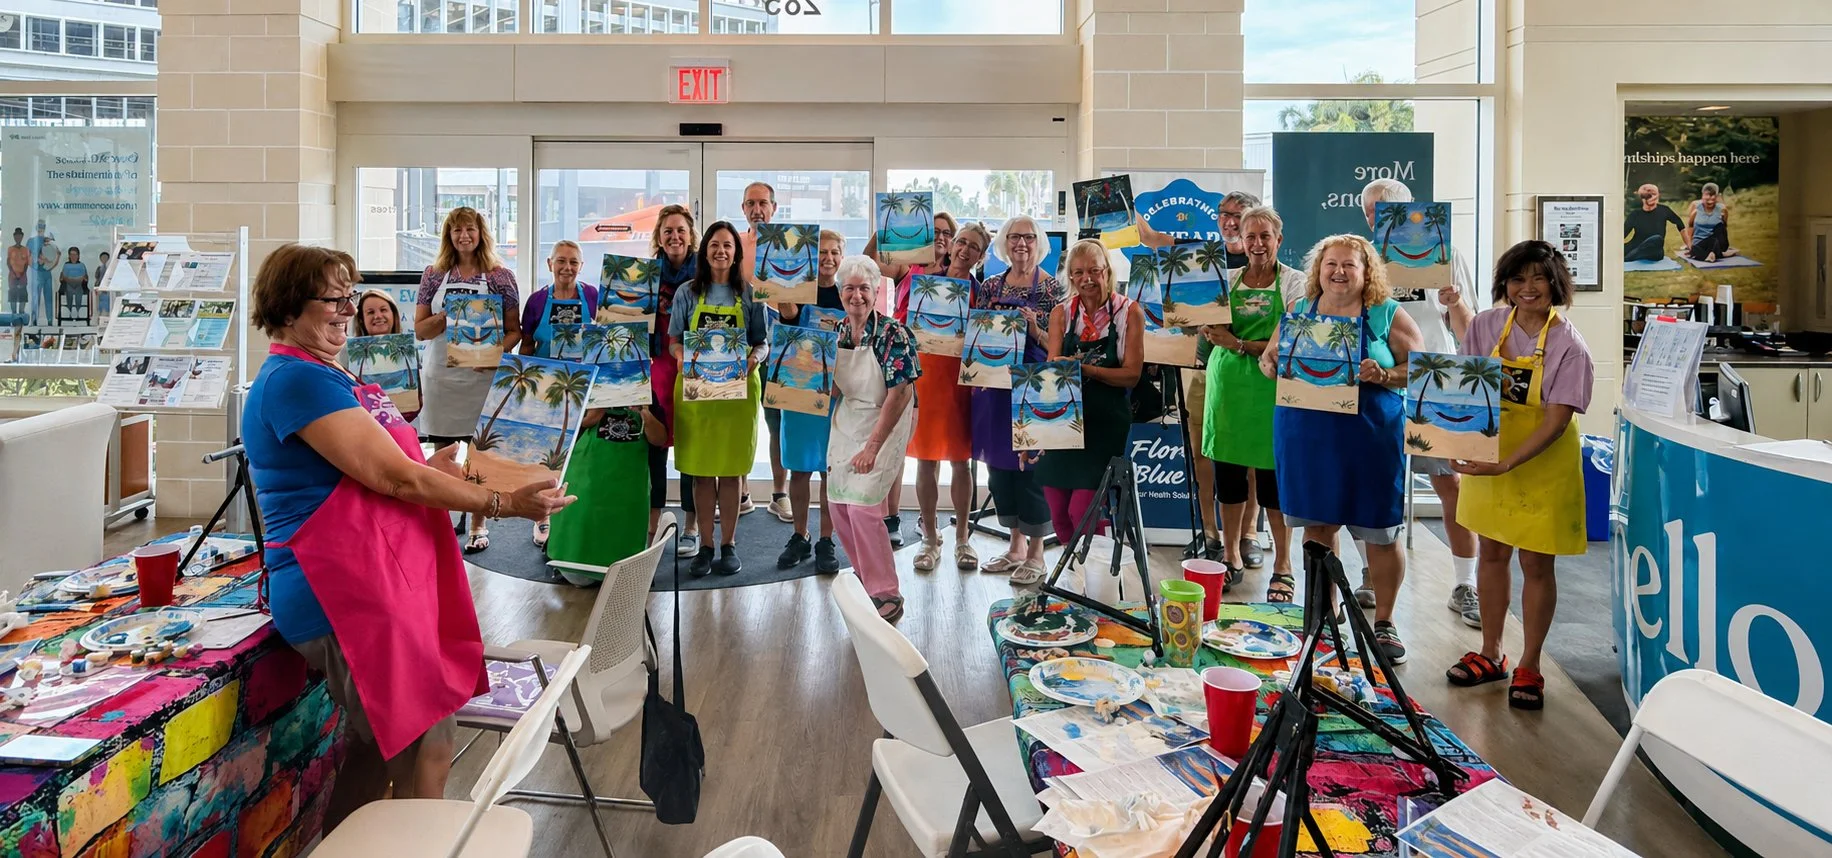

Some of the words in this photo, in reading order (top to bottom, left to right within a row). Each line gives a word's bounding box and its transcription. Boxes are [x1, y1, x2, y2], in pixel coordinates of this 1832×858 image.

[679, 69, 723, 100] EXIT
[1678, 152, 1728, 166] happen
[1730, 152, 1760, 164] here
[1130, 436, 1186, 460] Flor
[1134, 462, 1186, 485] Blue
[1148, 490, 1171, 499] Health
